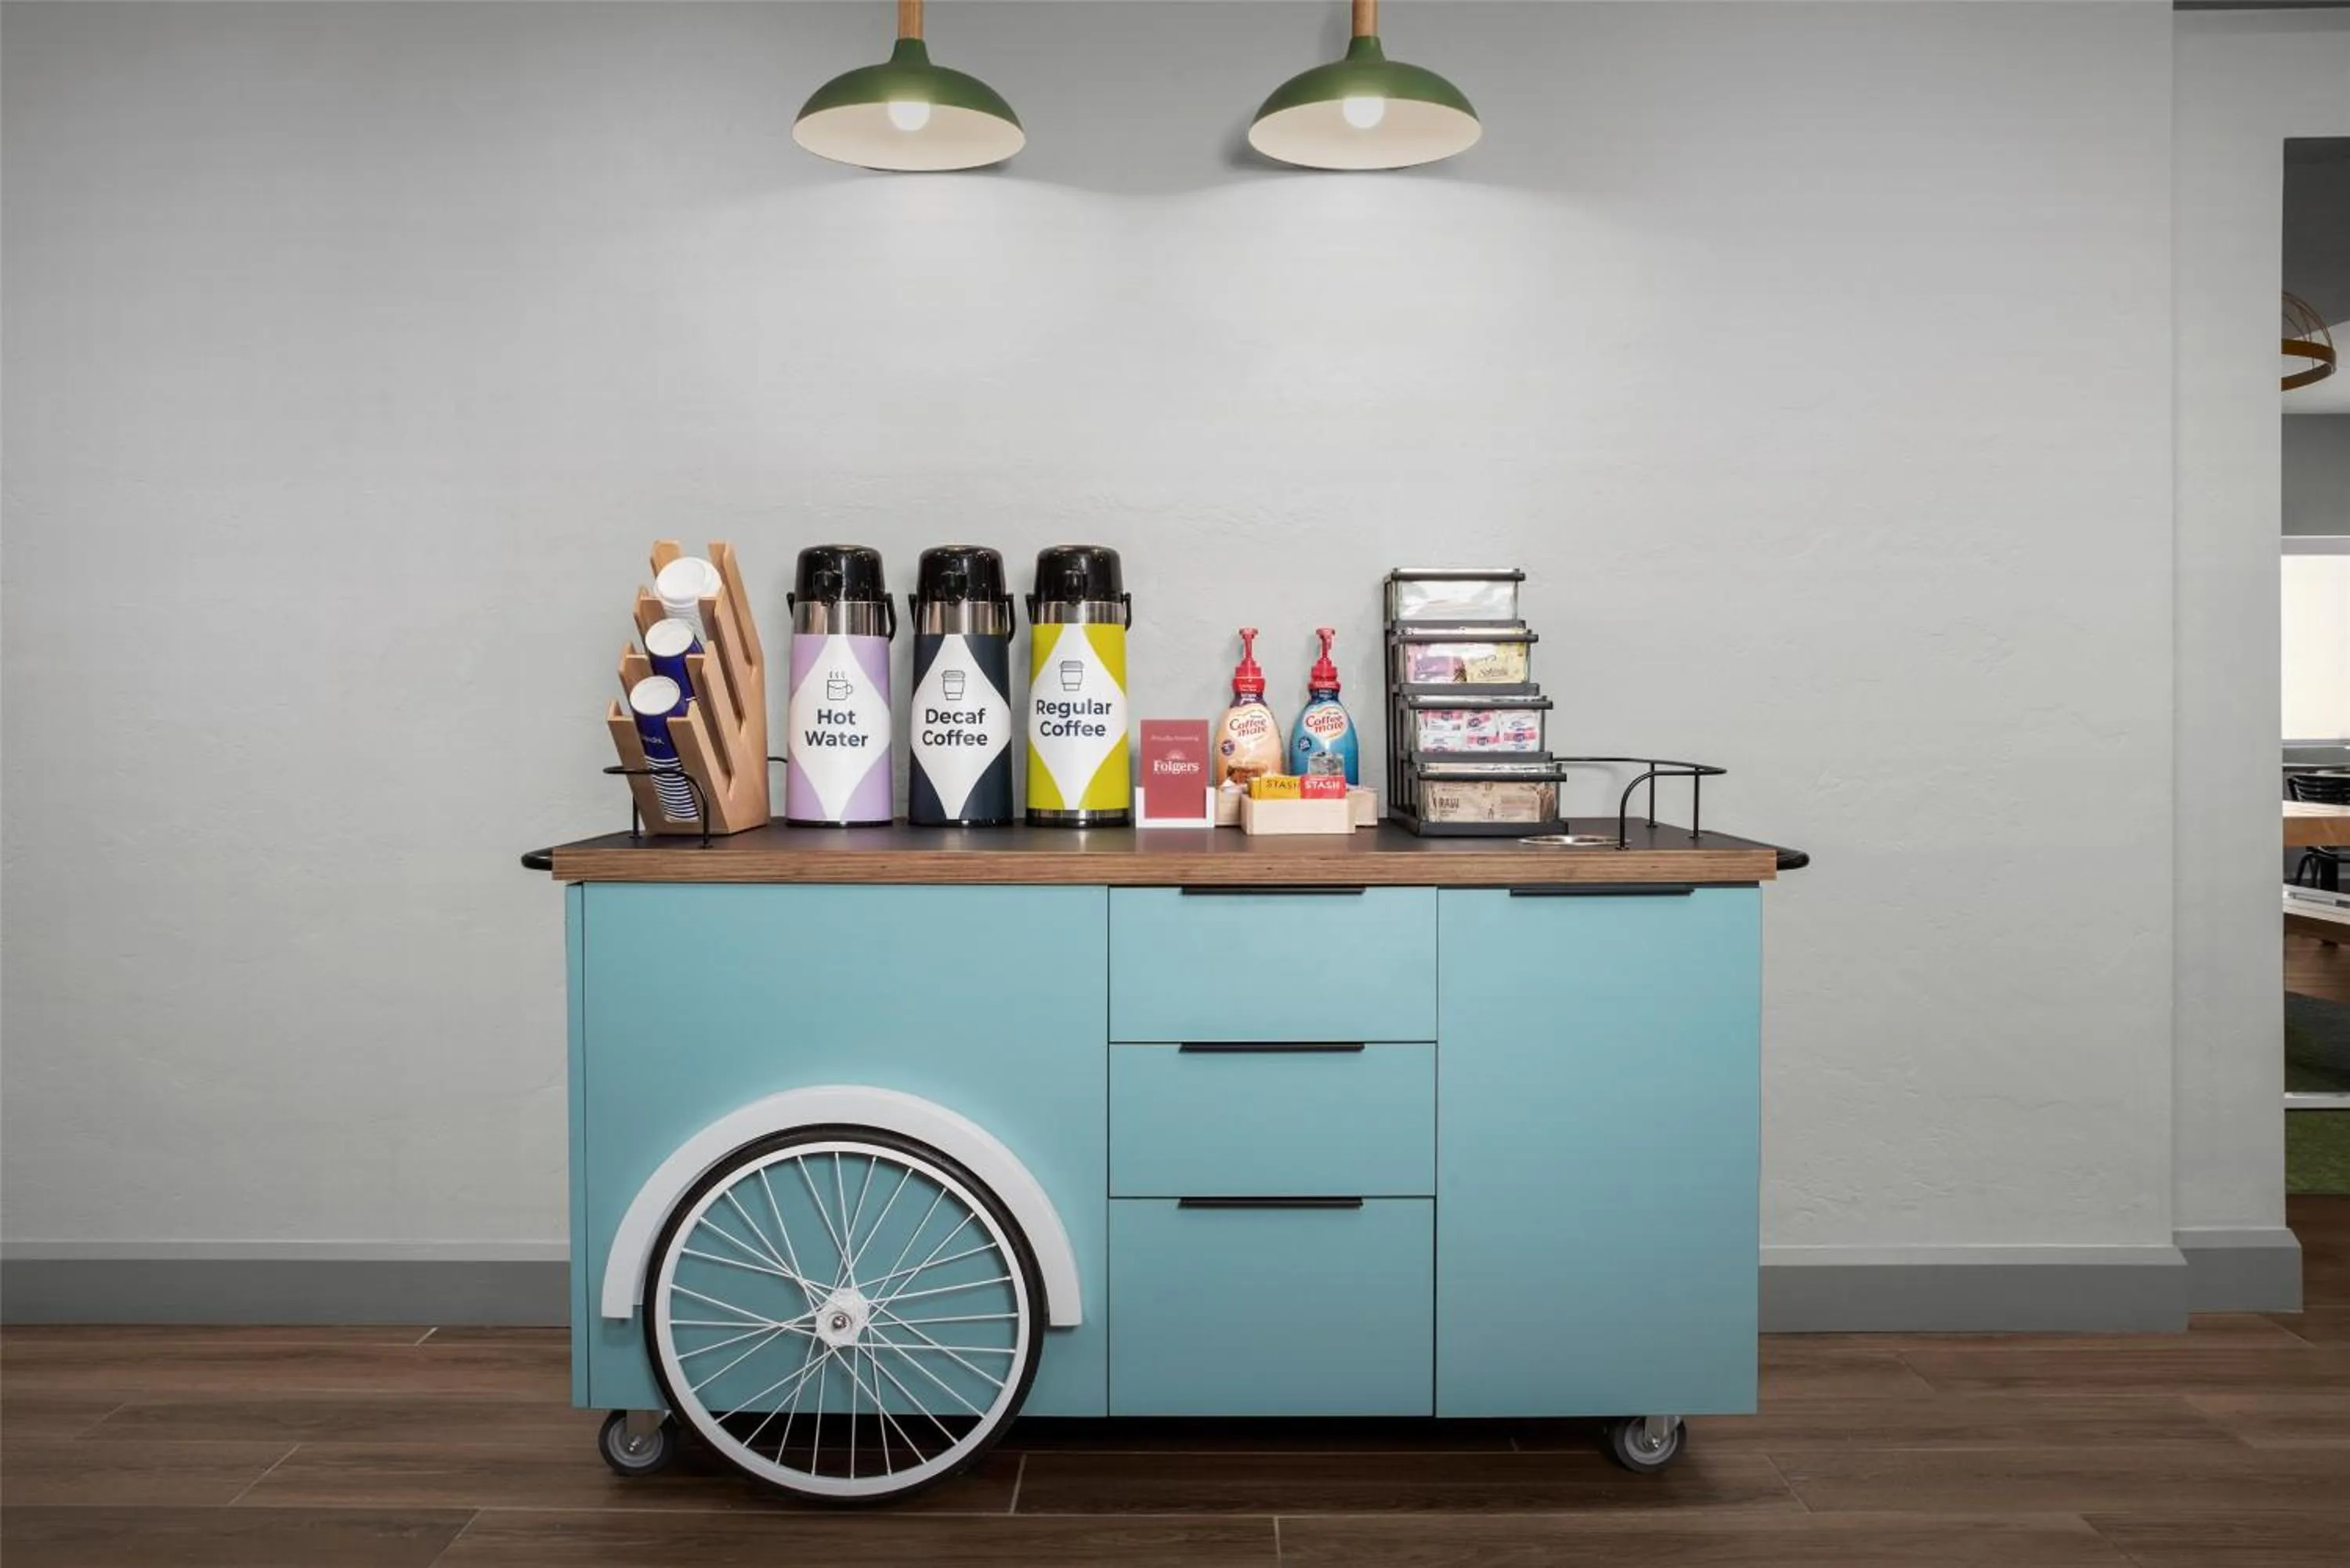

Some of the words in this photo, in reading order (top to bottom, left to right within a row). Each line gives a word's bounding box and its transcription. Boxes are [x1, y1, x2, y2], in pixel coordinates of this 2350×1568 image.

[817, 708, 856, 725] Hot
[925, 707, 986, 724] Decaf
[1036, 698, 1112, 718] Regular
[1039, 720, 1106, 737] Coffee
[1229, 718, 1267, 731] Coffee
[1306, 714, 1343, 728] Coffee
[804, 730, 869, 747] Water
[922, 729, 988, 746] Coffee
[1153, 760, 1200, 775] Folgers
[1304, 780, 1340, 790] STASH
